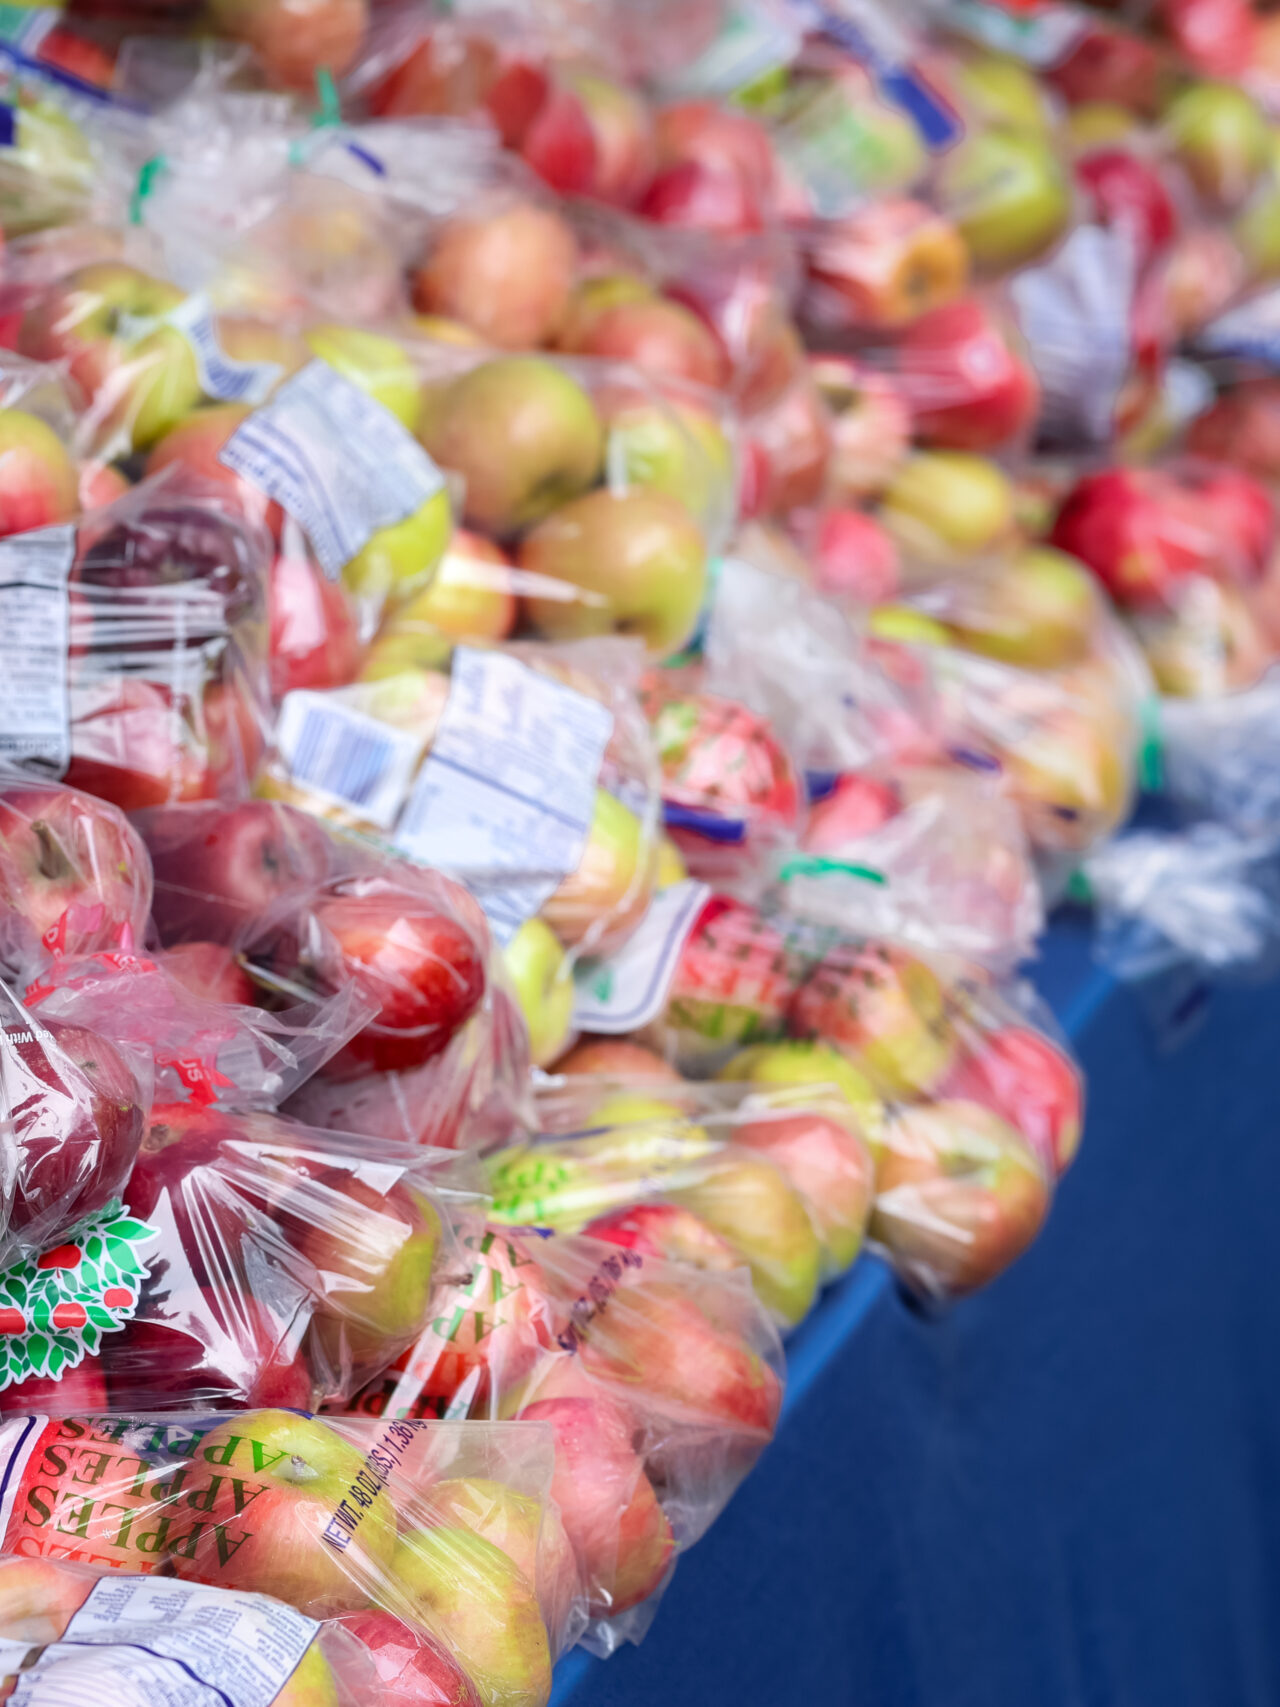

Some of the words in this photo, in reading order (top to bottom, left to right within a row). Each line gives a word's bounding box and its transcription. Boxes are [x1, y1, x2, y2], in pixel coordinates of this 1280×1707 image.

[57, 1416, 289, 1473] APPLES
[383, 1421, 415, 1453] 1.36
[38, 1444, 271, 1515] APPLES
[348, 1485, 374, 1509] 48
[356, 1470, 382, 1497] OZ
[23, 1485, 254, 1568] APPLES
